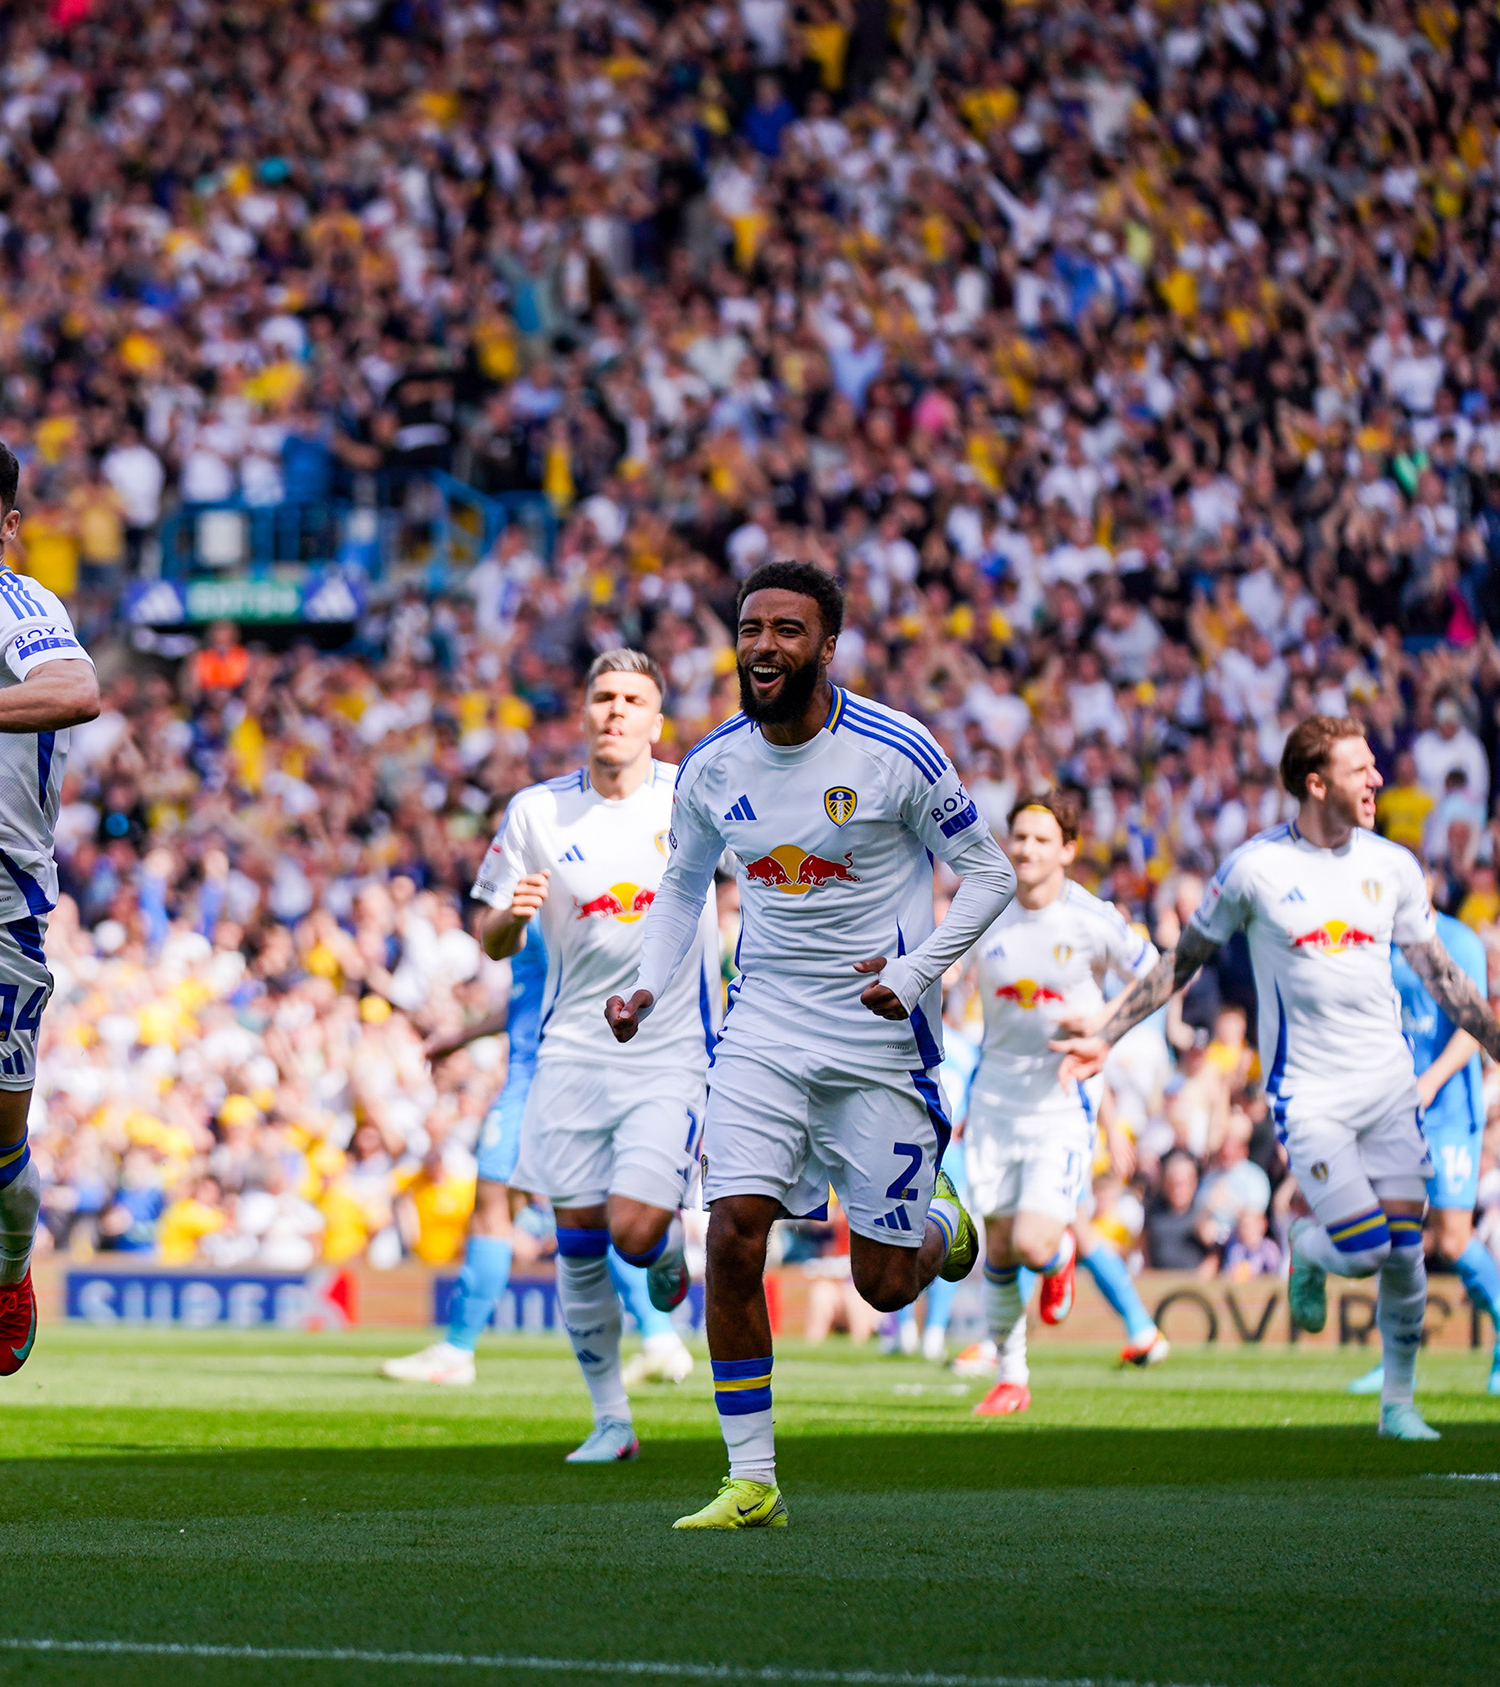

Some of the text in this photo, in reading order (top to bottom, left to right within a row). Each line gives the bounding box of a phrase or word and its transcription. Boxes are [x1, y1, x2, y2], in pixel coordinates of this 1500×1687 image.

[28, 638, 69, 654] LIFE
[931, 783, 967, 822] BOX
[886, 1142, 923, 1201] 2
